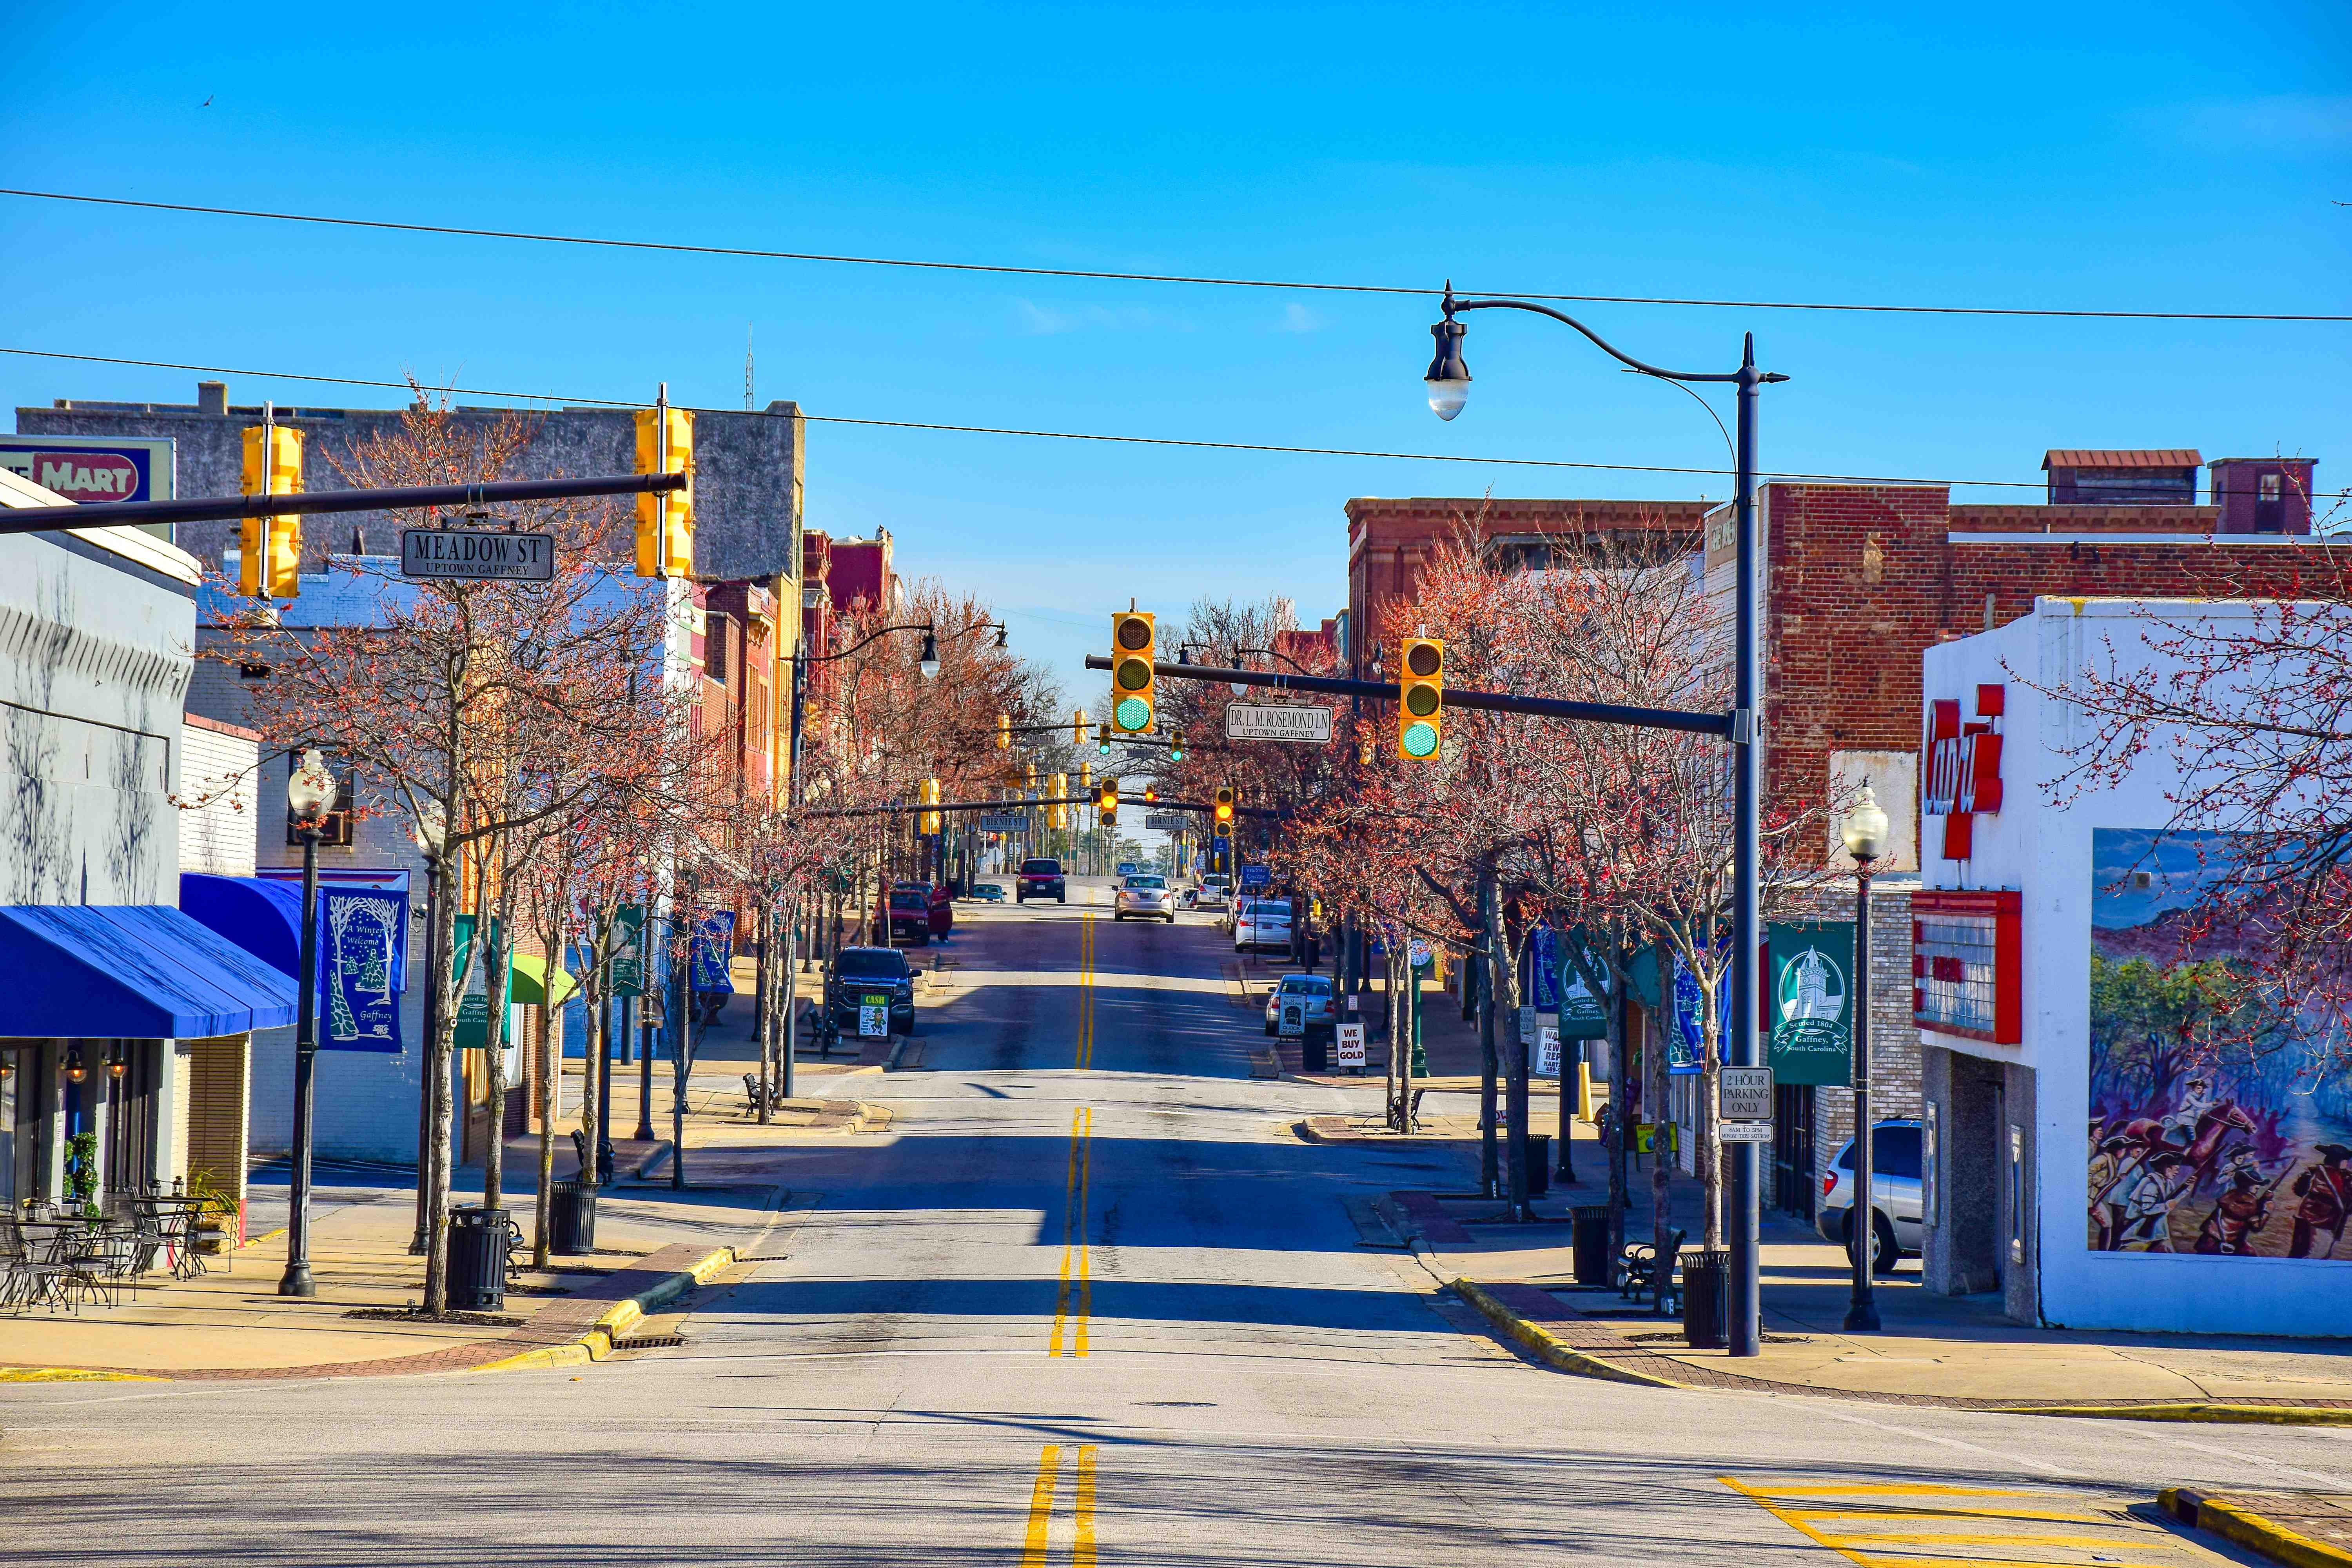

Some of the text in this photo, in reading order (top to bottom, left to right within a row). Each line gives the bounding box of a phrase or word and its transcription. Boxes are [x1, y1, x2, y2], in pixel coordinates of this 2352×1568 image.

[42, 461, 131, 492] MART
[414, 535, 541, 563] MEADOW ST
[426, 563, 530, 575] UPTOWN GAFFNEY
[1231, 710, 1328, 729] DR. L. M. ROSEMOND LN
[987, 817, 1023, 826] BIRNIE ST
[356, 925, 385, 934] Winter
[347, 936, 379, 946] Welcome
[866, 996, 885, 1004] CASH
[360, 1010, 392, 1022] Gaffney
[1789, 1020, 1833, 1029] Settled 1804
[1342, 1040, 1360, 1048] BUY
[1795, 1035, 1828, 1045] Gaffney,
[1339, 1051, 1364, 1060] GOLD
[1727, 1075, 1765, 1085] 2 HOUR
[1723, 1089, 1769, 1099] PARKING
[1732, 1102, 1760, 1113] ONLY
